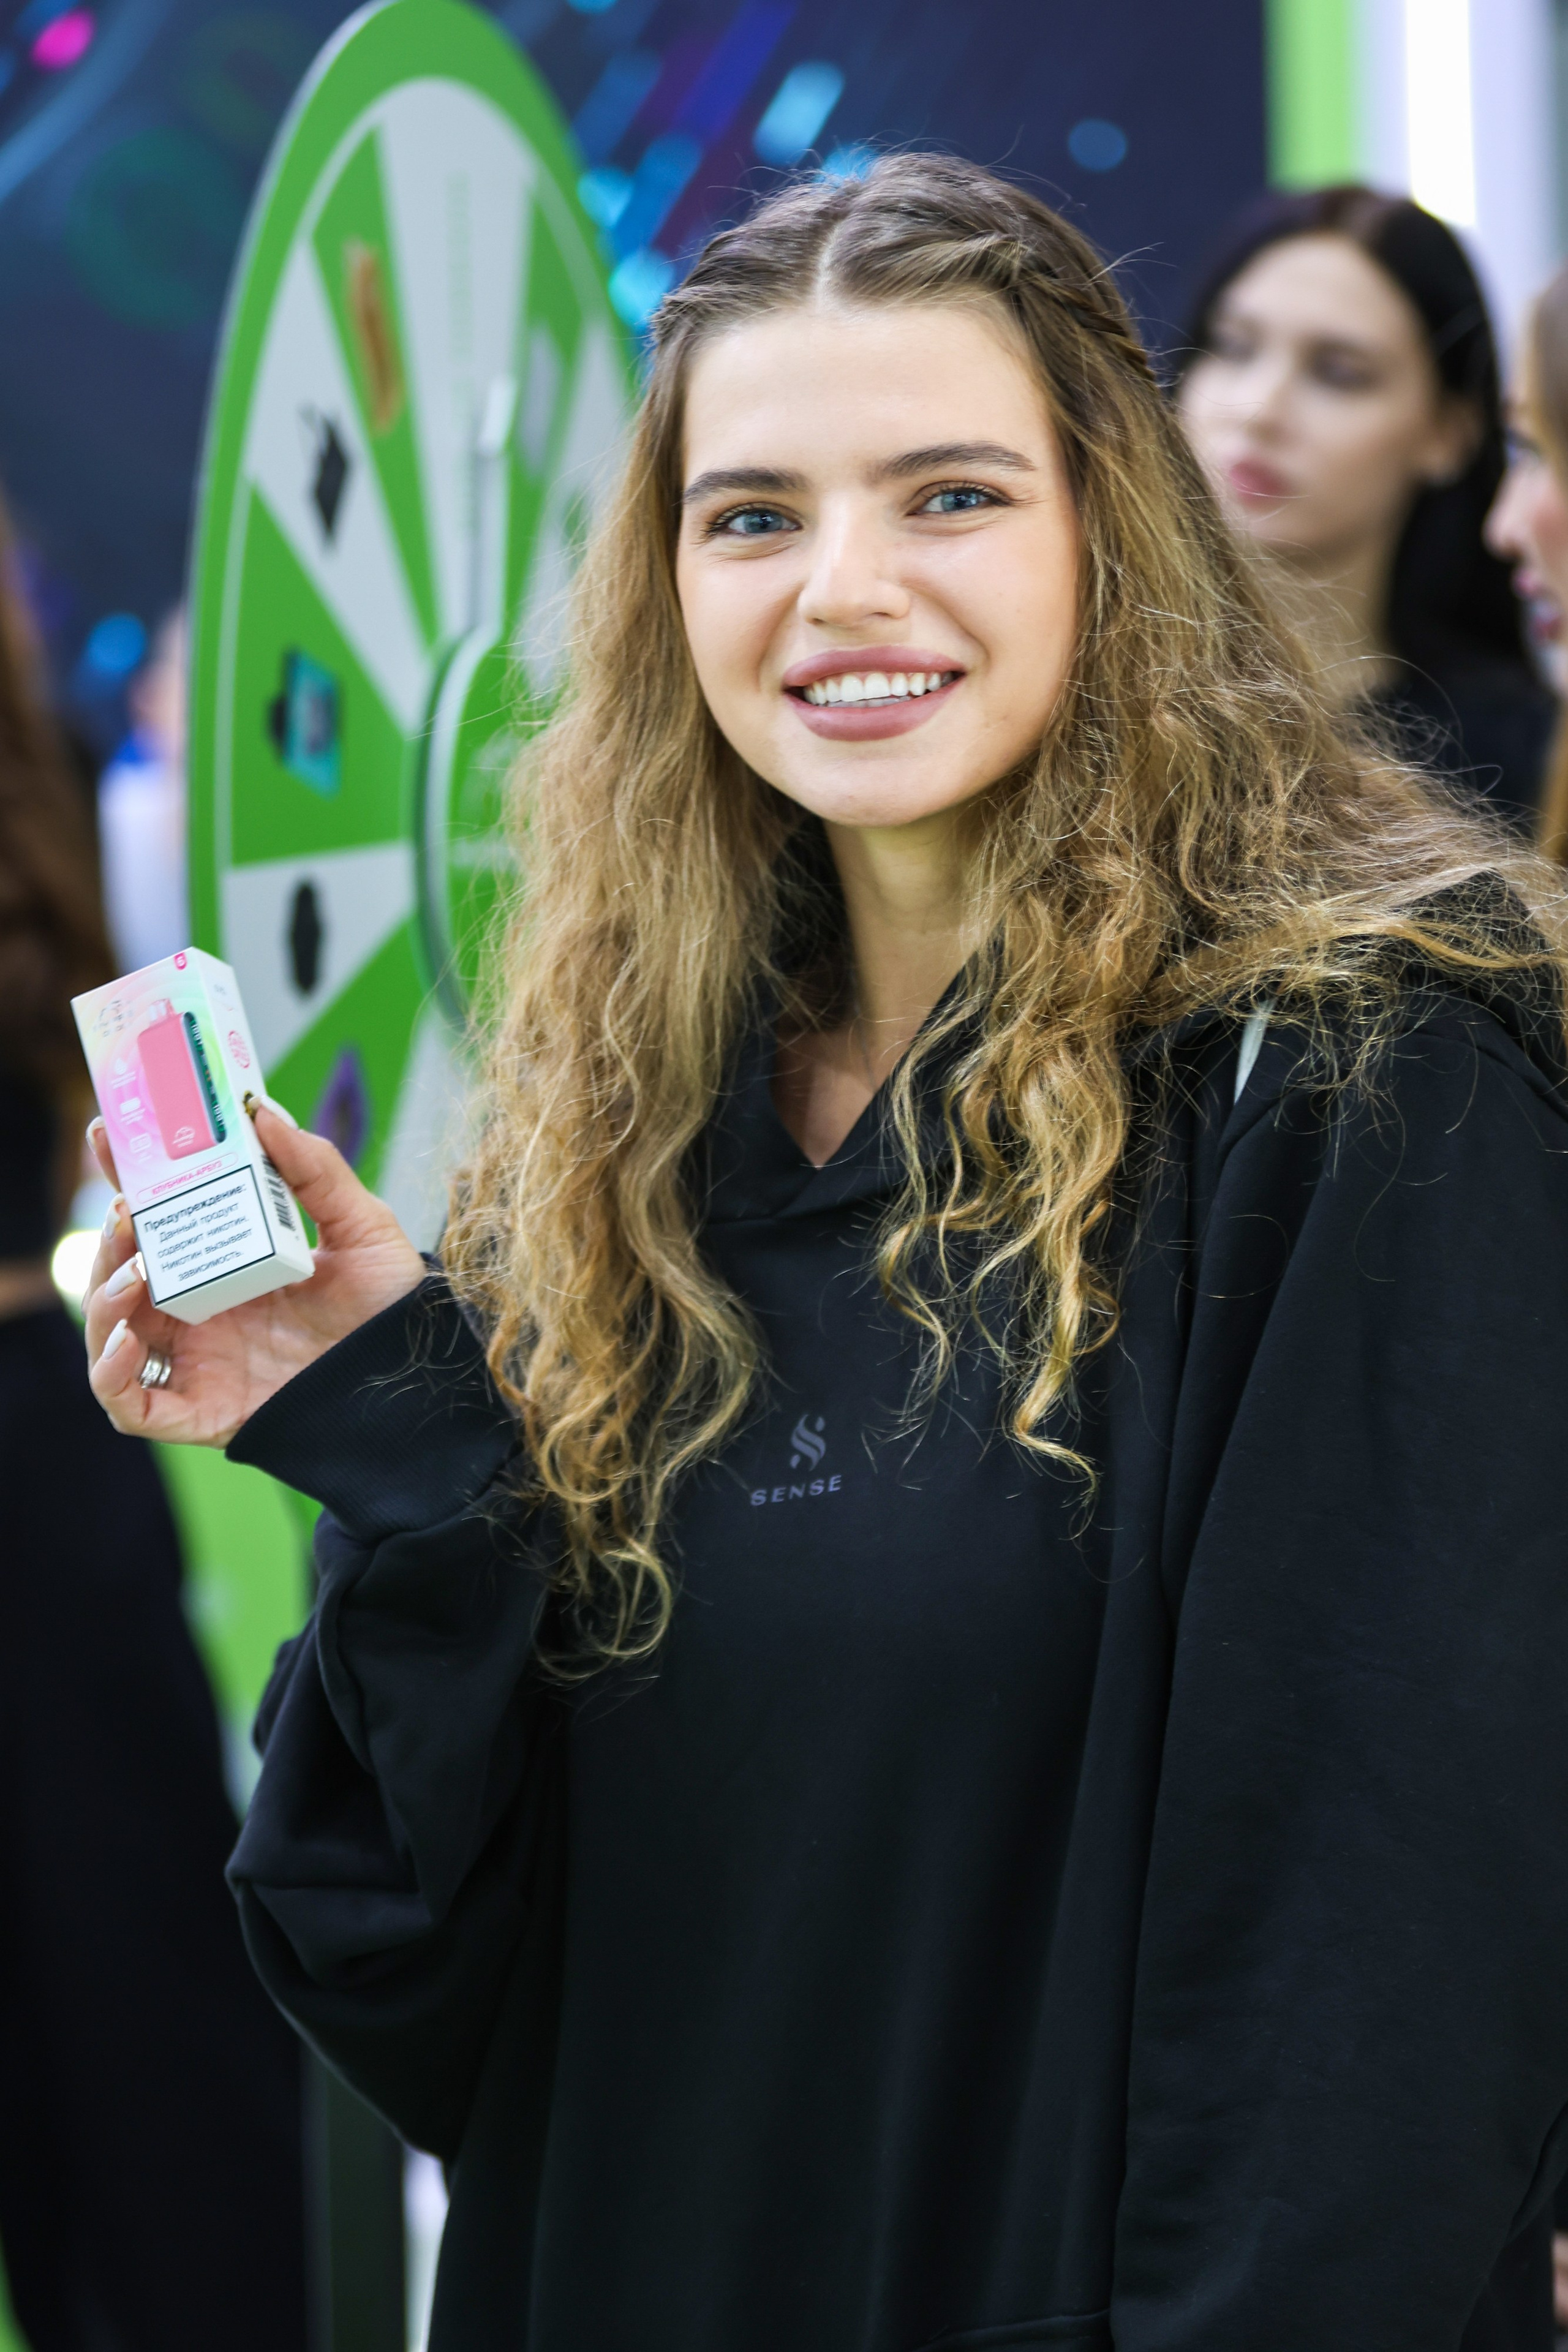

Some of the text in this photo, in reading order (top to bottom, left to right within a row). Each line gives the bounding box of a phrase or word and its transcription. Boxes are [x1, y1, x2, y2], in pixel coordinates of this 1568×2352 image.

[144, 1183, 247, 1232] Предупреждение:
[160, 1202, 239, 1243] Данный продукт
[157, 1216, 249, 1258] содержит никотин.
[161, 1228, 252, 1273] Никотин вызывает
[177, 1250, 244, 1281] зависимость.
[750, 1475, 842, 1507] SENSE
